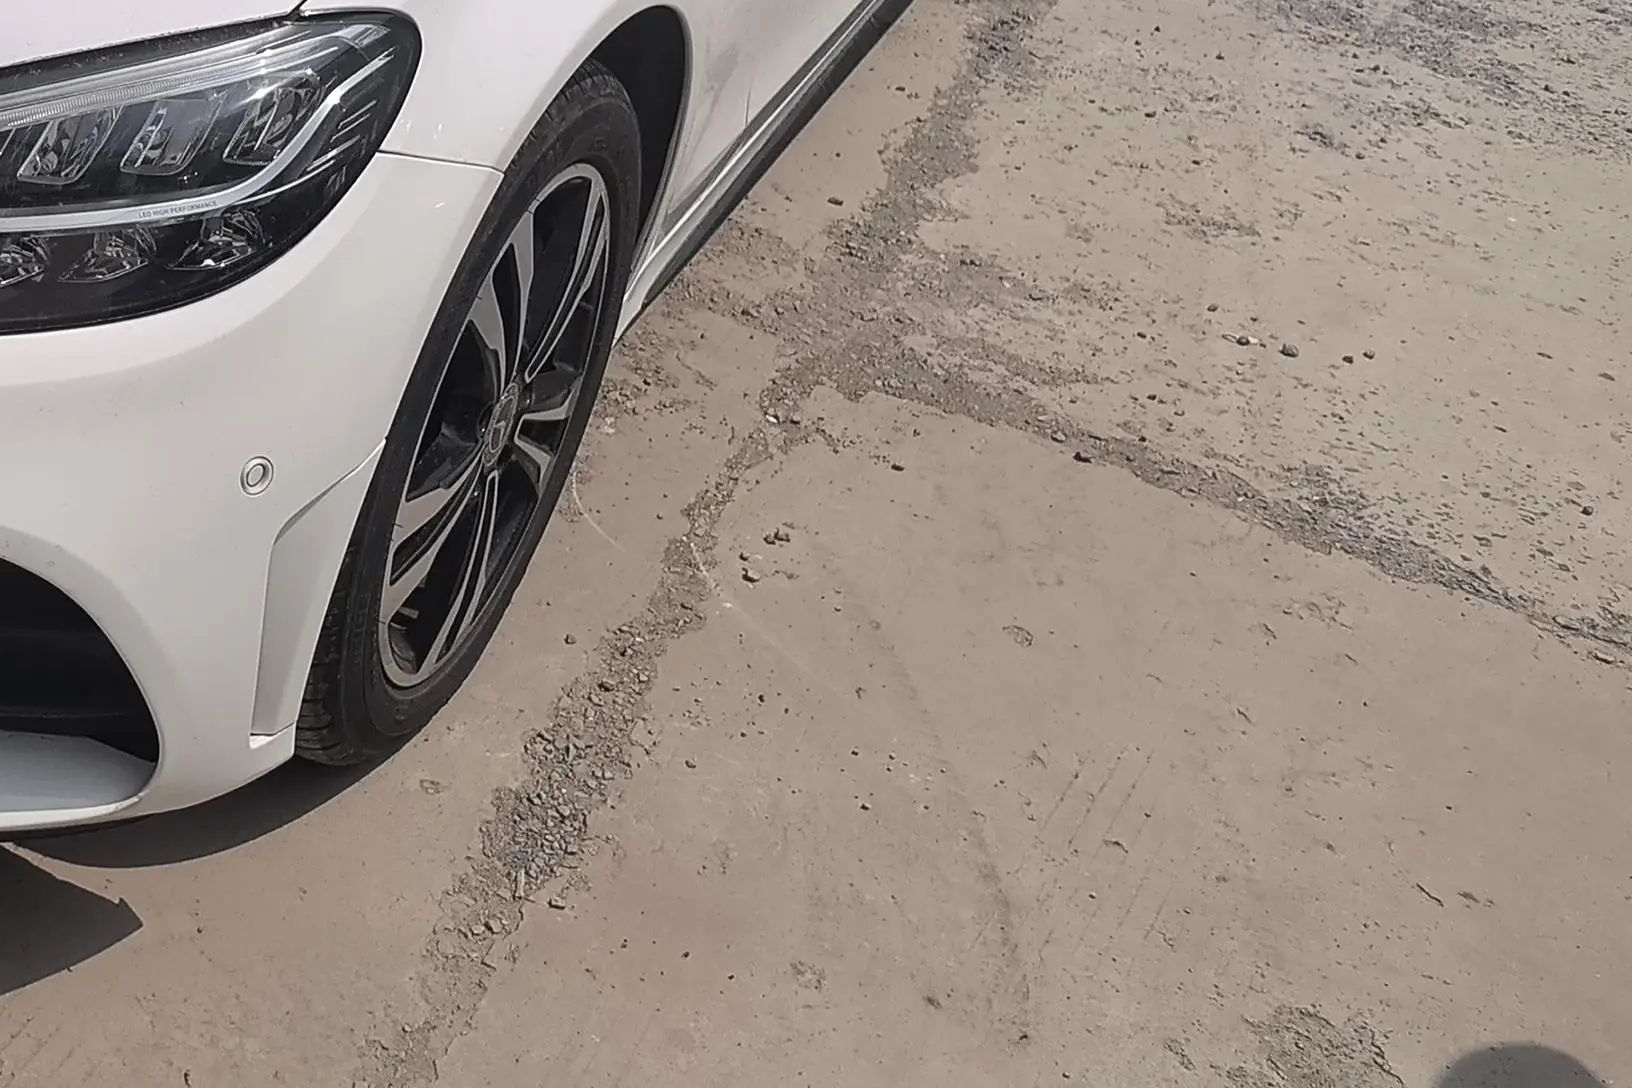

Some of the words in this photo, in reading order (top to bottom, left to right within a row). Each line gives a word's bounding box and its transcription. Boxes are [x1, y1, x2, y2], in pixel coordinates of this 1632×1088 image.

[138, 211, 152, 219] LED
[152, 208, 169, 217] HIGH
[170, 200, 217, 214] PERFORMANCE
